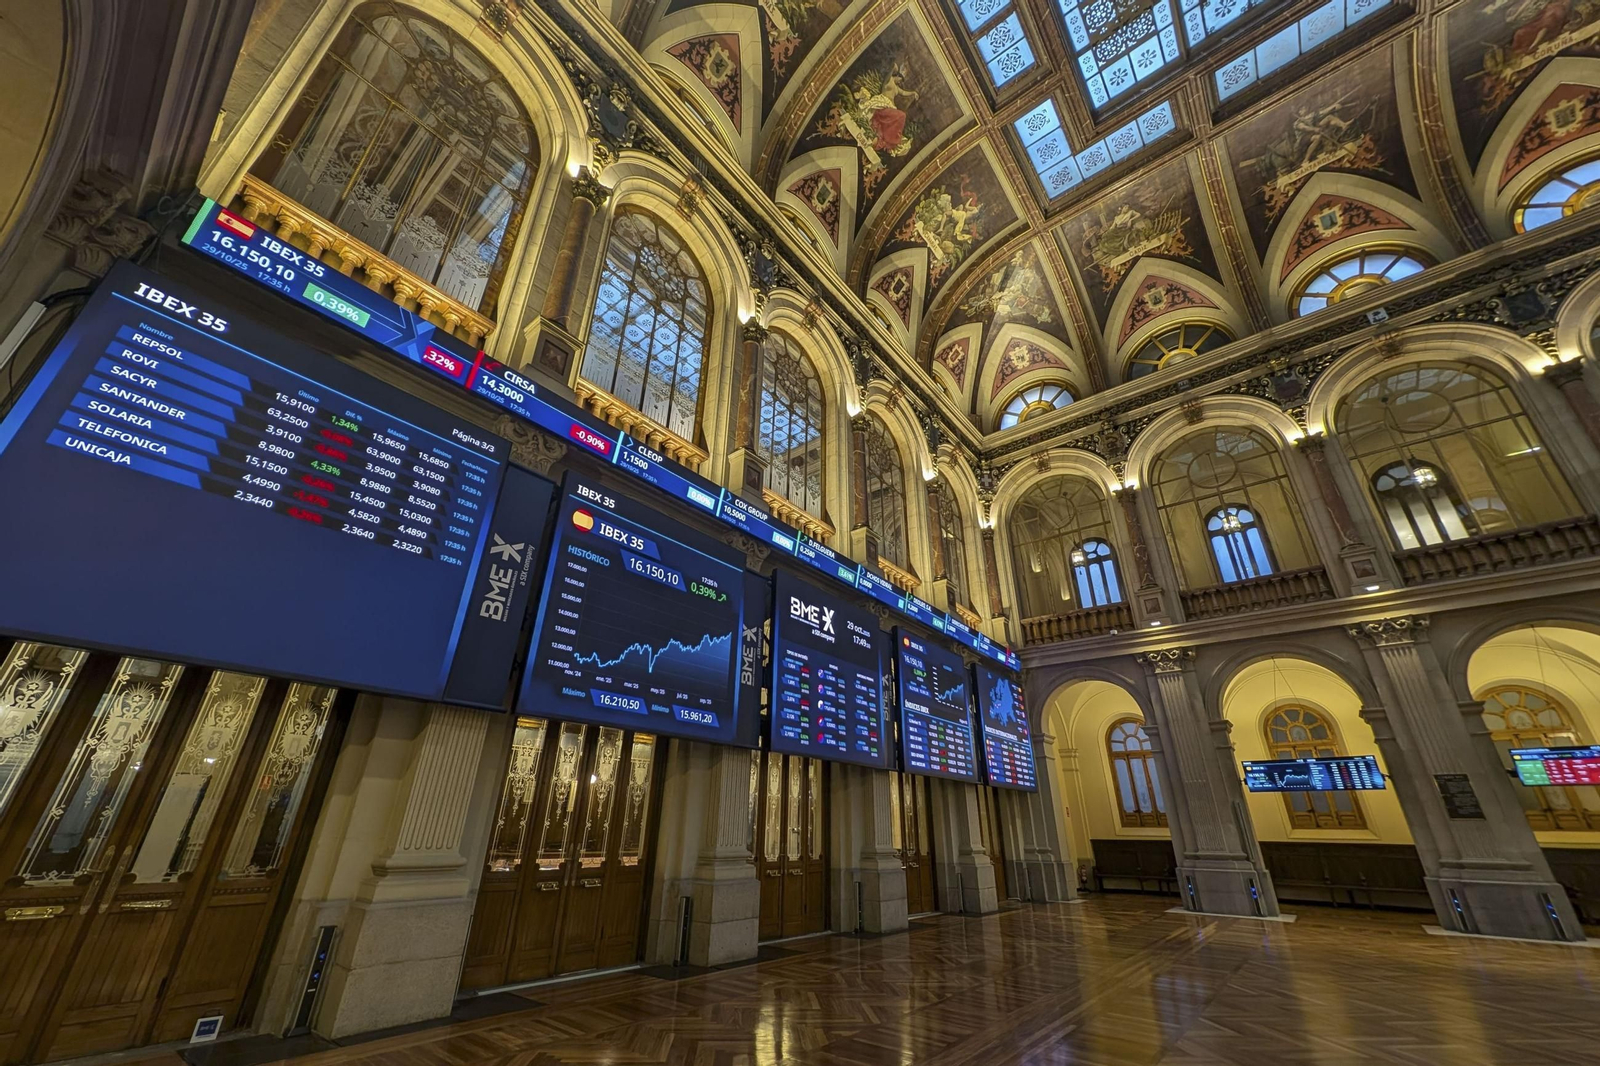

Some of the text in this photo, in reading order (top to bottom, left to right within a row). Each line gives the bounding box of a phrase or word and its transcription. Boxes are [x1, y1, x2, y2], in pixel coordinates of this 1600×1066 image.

[211, 230, 296, 282] 16.150,10
[260, 235, 326, 278] IBEX 35
[201, 242, 291, 293] 29/10/25 17:35 h
[134, 282, 228, 332] IBEX 35
[313, 290, 360, 322] 0,39%
[138, 322, 174, 341] Nombre
[132, 333, 184, 360] REPSOL
[121, 349, 159, 370] ROVI
[110, 365, 158, 389] SACYR
[503, 370, 536, 394] CIRSA
[298, 389, 320, 403] Último
[481, 374, 524, 404] 14,3000
[99, 382, 186, 420] SANTANDER
[275, 392, 315, 414] 15,9100
[476, 385, 505, 404] 29/10/25
[509, 402, 526, 416] 17:35
[88, 400, 153, 429] SOLARIA
[267, 407, 309, 429] 63,2500
[331, 415, 359, 433] 1,34%
[78, 418, 168, 455] TELEFONICA
[265, 424, 302, 444] 3,9100
[372, 432, 407, 452] 15,9650
[452, 428, 495, 453] Página 3/3
[575, 429, 606, 451] -0,90%
[64, 437, 132, 465] UNICAJA
[258, 440, 295, 460] 8,9800
[366, 446, 401, 466] 63,9000
[638, 445, 663, 464] CLEOP
[245, 454, 288, 475] 15,1500
[310, 460, 341, 477] 4,33%
[418, 451, 450, 470] 15,6850
[622, 450, 649, 471] 1,1500
[365, 462, 396, 480] 3,9500
[412, 465, 445, 483] 63,1500
[465, 471, 480, 482] 17:35
[242, 473, 281, 491] 4,4990
[359, 477, 391, 494] 8,9880
[412, 480, 441, 497] 3,9080
[461, 484, 477, 496] 17:35
[234, 490, 273, 508] 2,3440
[350, 490, 386, 509] 15,4500
[407, 494, 436, 511] 8,5520
[457, 497, 473, 509] 17:35
[577, 484, 616, 509] IBEX 35
[348, 508, 381, 525] 4,5820
[399, 508, 432, 525] 15,0300
[453, 511, 469, 523] 17:35
[723, 504, 746, 522] 10,5000
[734, 498, 768, 521] COX GROUP
[341, 523, 375, 540] 2,3640
[397, 524, 427, 540] 4,4890
[448, 525, 465, 536] 17:35
[599, 522, 645, 551] IBEX 35
[392, 539, 422, 555] 2,3220
[444, 540, 461, 551] 17:35
[567, 544, 610, 567] HISTÓRICO
[440, 554, 457, 565] 17:35
[524, 544, 536, 571] company
[629, 557, 679, 585] 16.150,10
[479, 563, 513, 621] BME
[690, 581, 717, 600] 0,39%
[790, 596, 820, 624] BME
[741, 645, 753, 686] BME
[562, 687, 586, 698] Máximo
[599, 693, 640, 711] 16.210,50
[680, 709, 713, 723] 15.961,20
